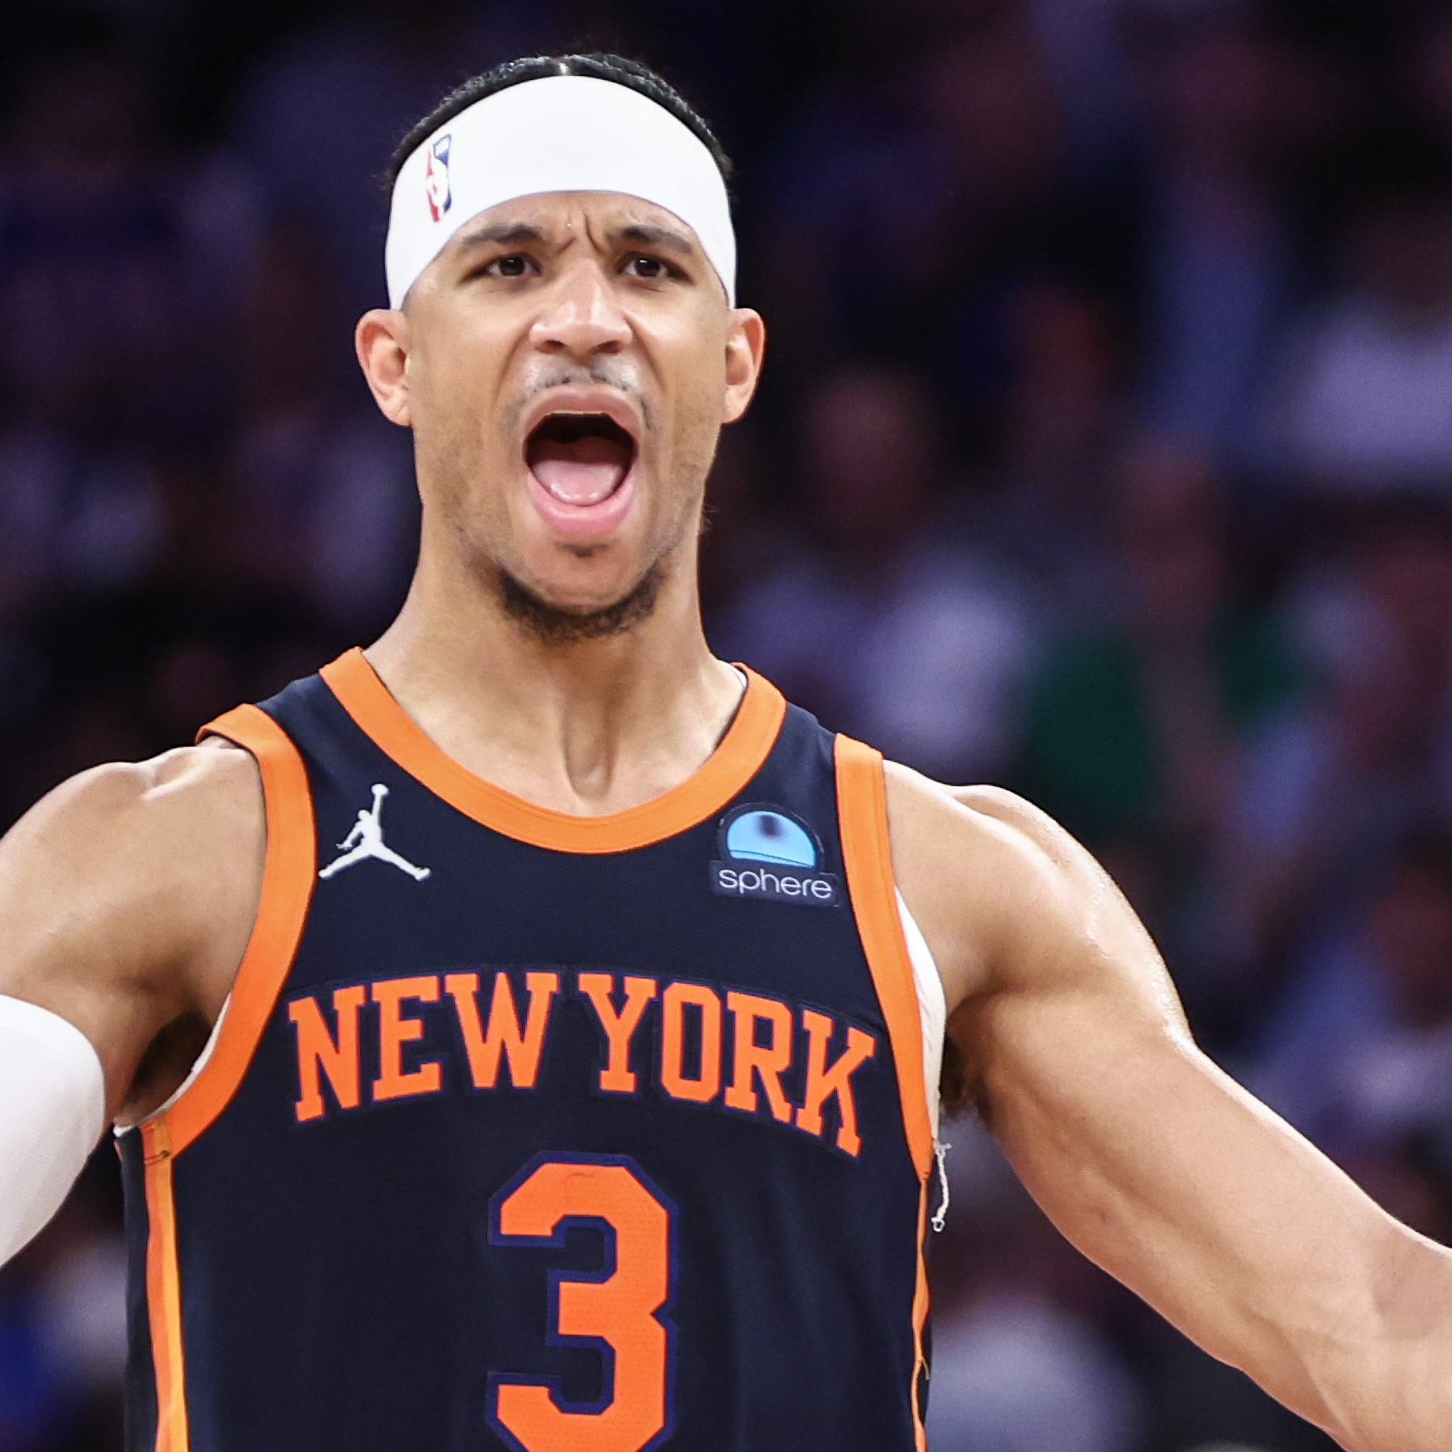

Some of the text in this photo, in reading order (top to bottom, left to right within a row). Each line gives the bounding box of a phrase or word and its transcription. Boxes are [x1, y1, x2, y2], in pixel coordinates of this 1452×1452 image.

[718, 868, 833, 899] sphere
[287, 970, 877, 1157] NEW YORK
